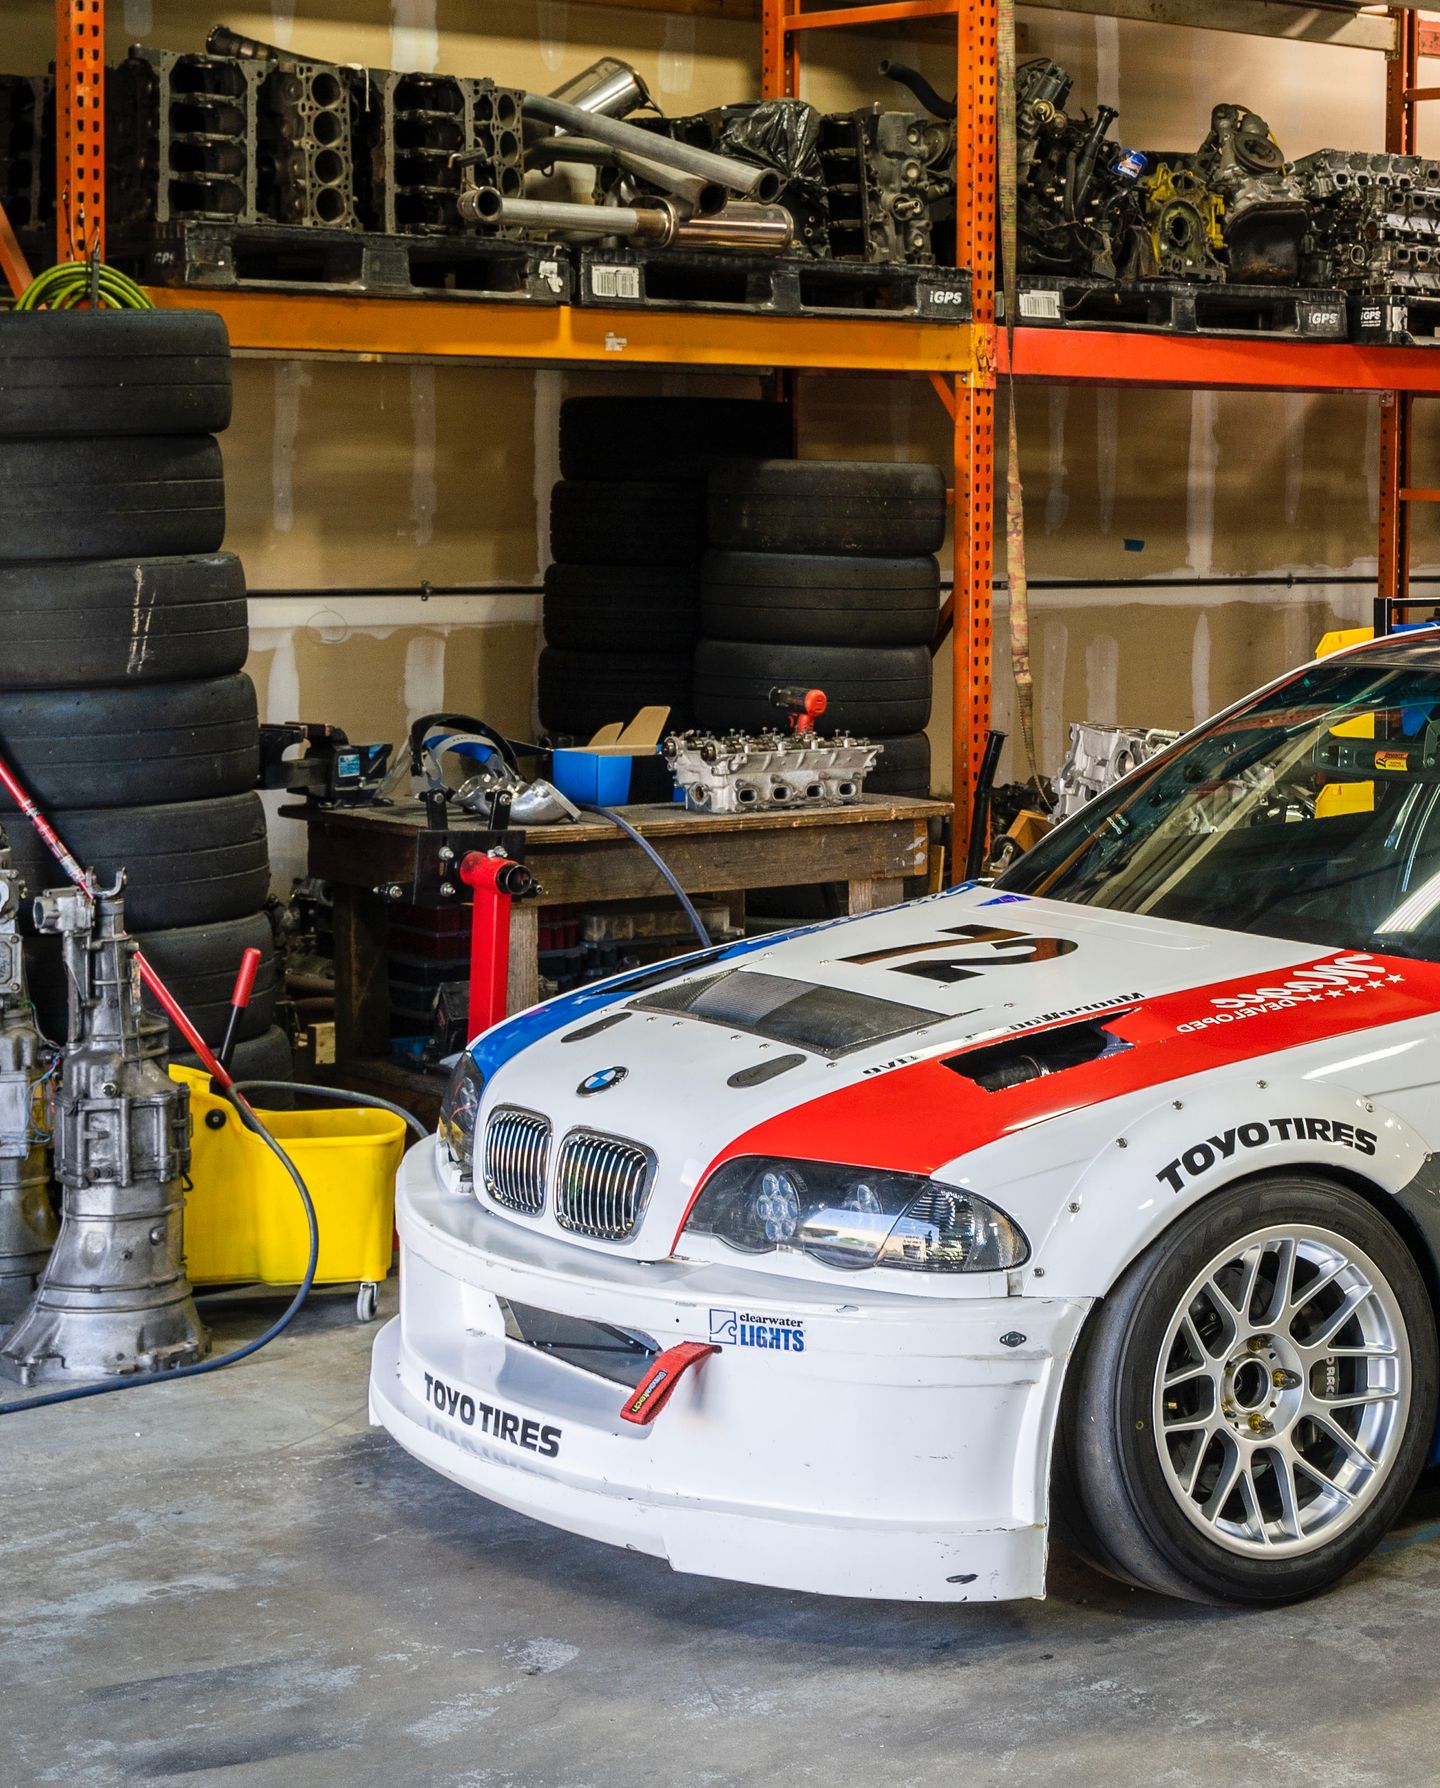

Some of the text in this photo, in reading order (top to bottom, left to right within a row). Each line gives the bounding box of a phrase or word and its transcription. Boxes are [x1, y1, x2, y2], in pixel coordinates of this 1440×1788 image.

[930, 290, 962, 304] iGPS
[1308, 312, 1338, 325] iGPS
[1360, 310, 1381, 320] iGPS
[835, 924, 1079, 984] 72
[1176, 999, 1297, 1034] DEVELOPED
[1155, 1117, 1378, 1194] TOYO TIRES
[739, 1313, 804, 1328] clearwater
[740, 1324, 805, 1352] LIGHTS
[424, 1371, 563, 1458] TOYO TIRES
